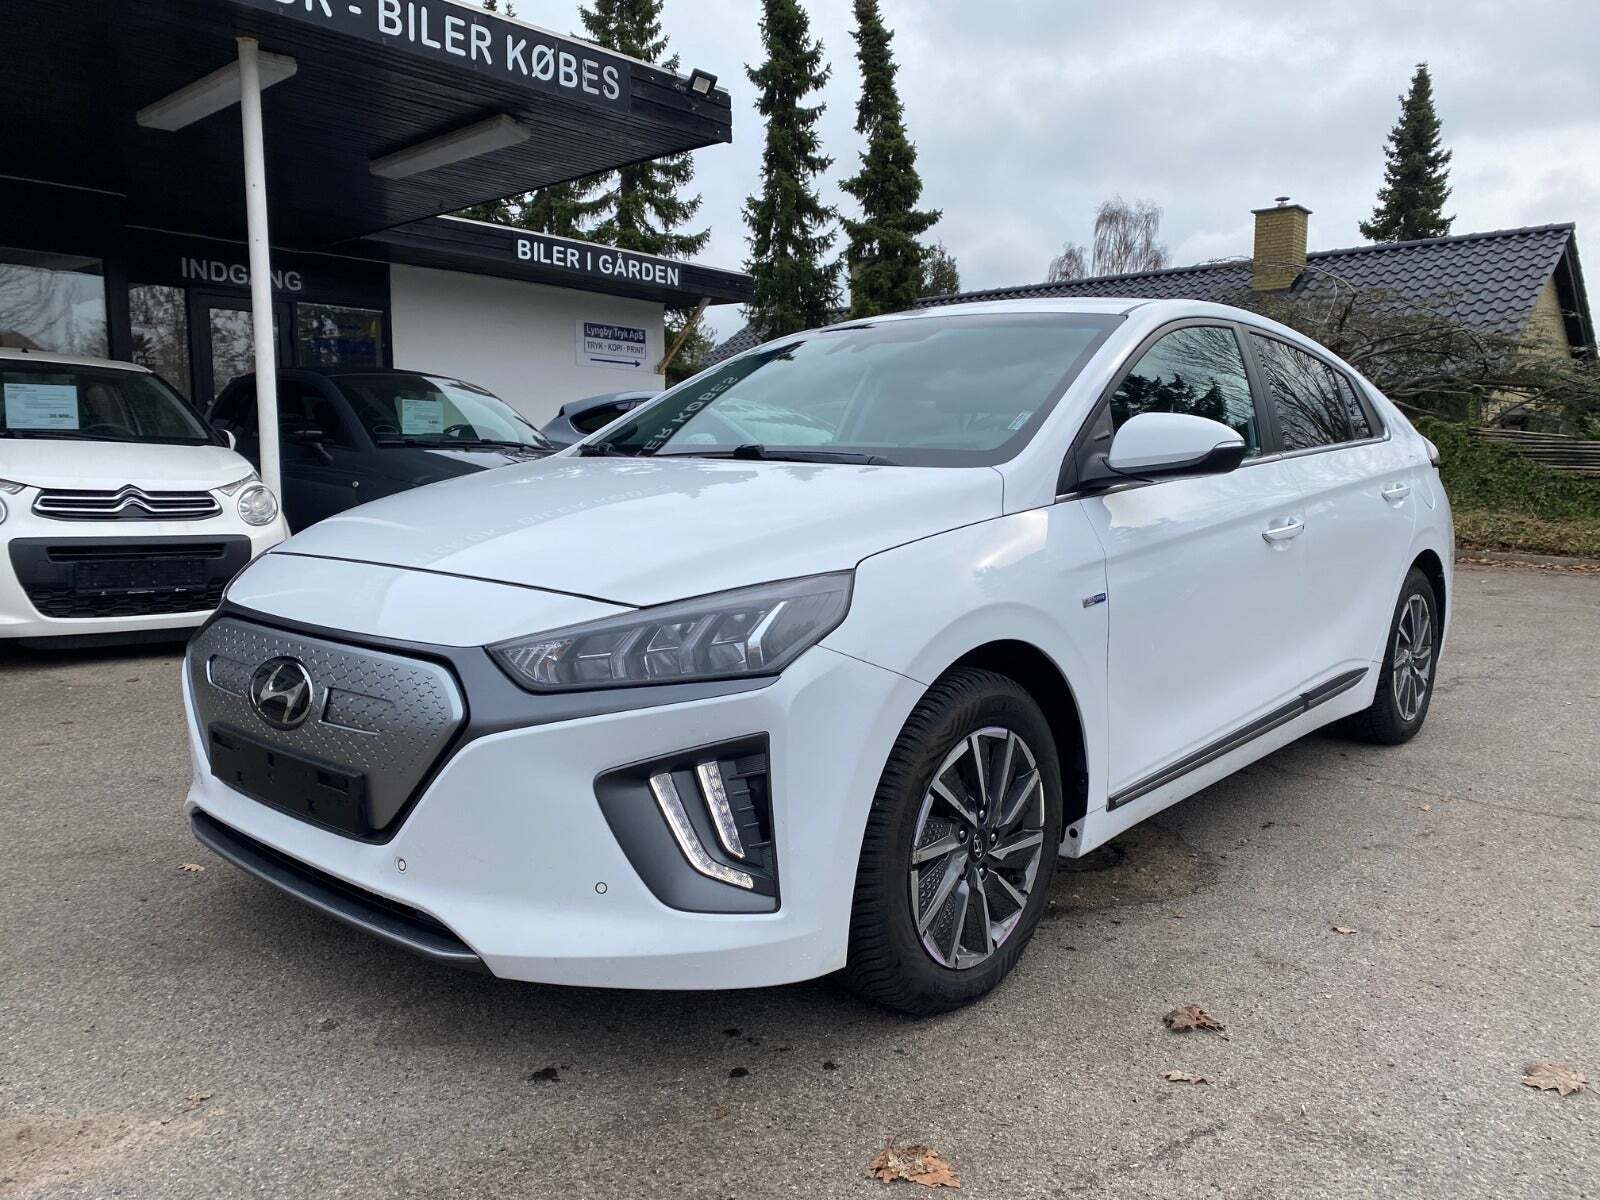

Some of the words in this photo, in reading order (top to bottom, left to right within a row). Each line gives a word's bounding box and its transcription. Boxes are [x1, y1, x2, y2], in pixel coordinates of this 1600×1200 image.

[378, 0, 493, 65] BILER
[506, 34, 620, 100] KØBES
[181, 257, 302, 291] INDGNG
[517, 239, 580, 269] BILER
[587, 251, 592, 271] I
[598, 252, 680, 287] GÅRDEN
[586, 323, 612, 338] Lyngby
[613, 327, 628, 340] Tryk
[629, 330, 644, 341] ApS
[586, 341, 604, 350] TRYK
[607, 343, 623, 352] KOPI
[626, 345, 645, 354] PRINT
